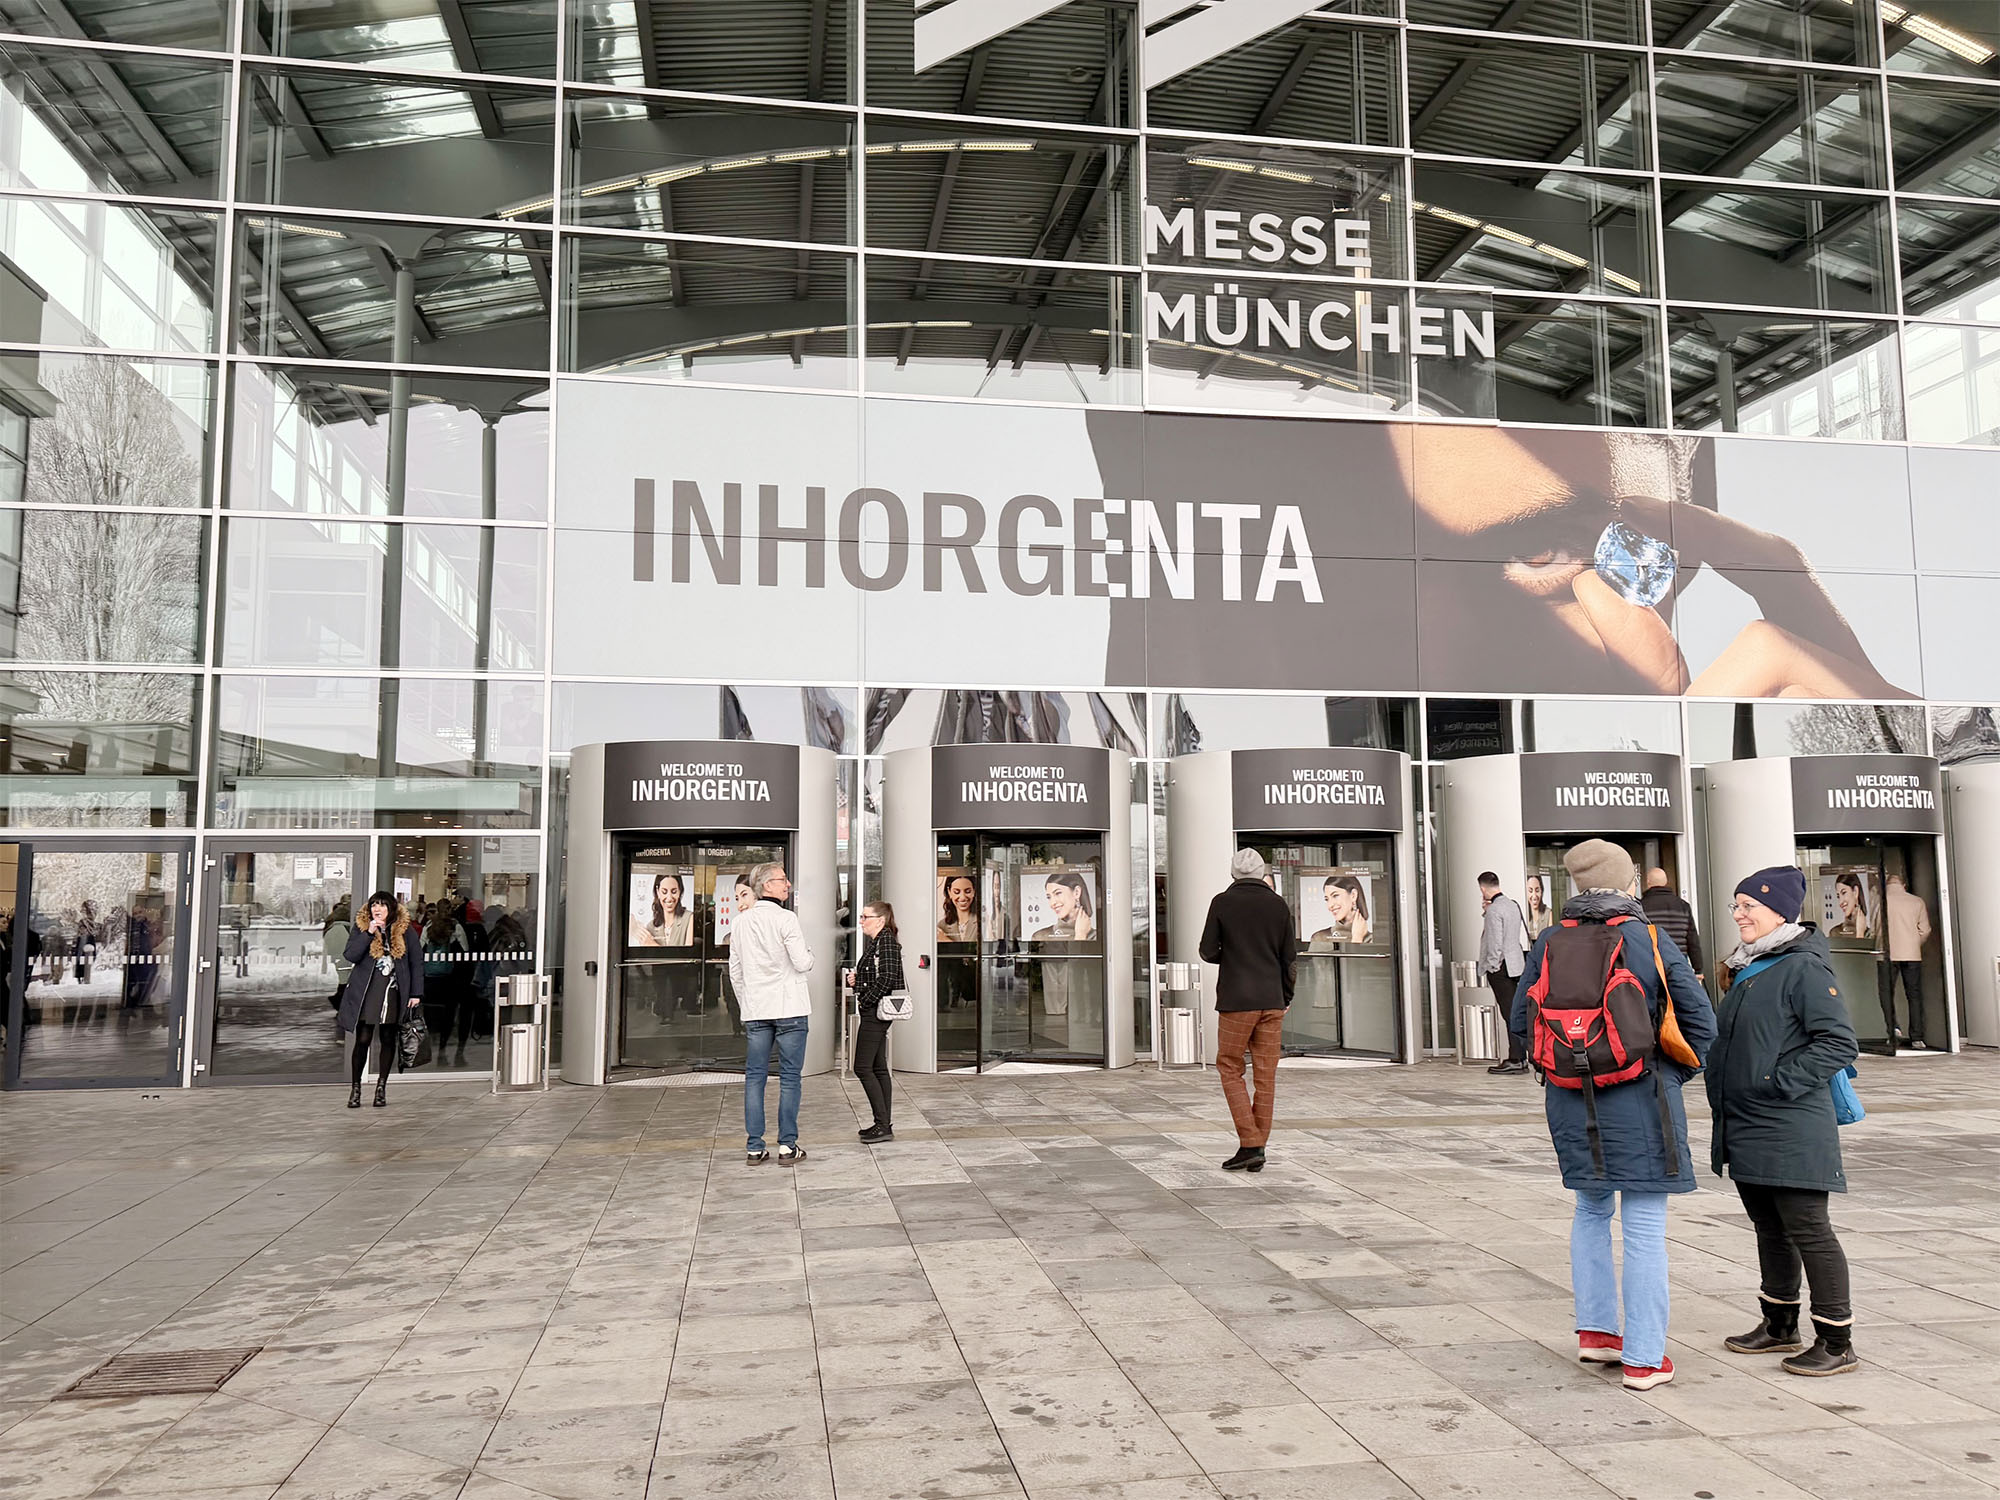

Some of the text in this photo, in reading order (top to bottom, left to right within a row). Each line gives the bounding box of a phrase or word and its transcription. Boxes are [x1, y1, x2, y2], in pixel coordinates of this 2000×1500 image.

[1146, 205, 1372, 267] MESSE
[1147, 283, 1495, 358] MÜNCHEN
[632, 477, 1325, 604] INHORGENTA
[660, 763, 743, 777] WELCOME TO
[989, 766, 1065, 780] WELCOME TO
[1293, 769, 1364, 783] WELCOME TO
[1584, 772, 1653, 785] WELCOME TO
[632, 779, 771, 802] INHORGENTA
[962, 781, 1087, 803] INHORGENTA
[1856, 775, 1920, 788] WELCOME TO
[1265, 784, 1385, 805] INHORGENTA
[1556, 786, 1671, 808] INHORGENTA
[1828, 789, 1935, 810] INHORGENTA
